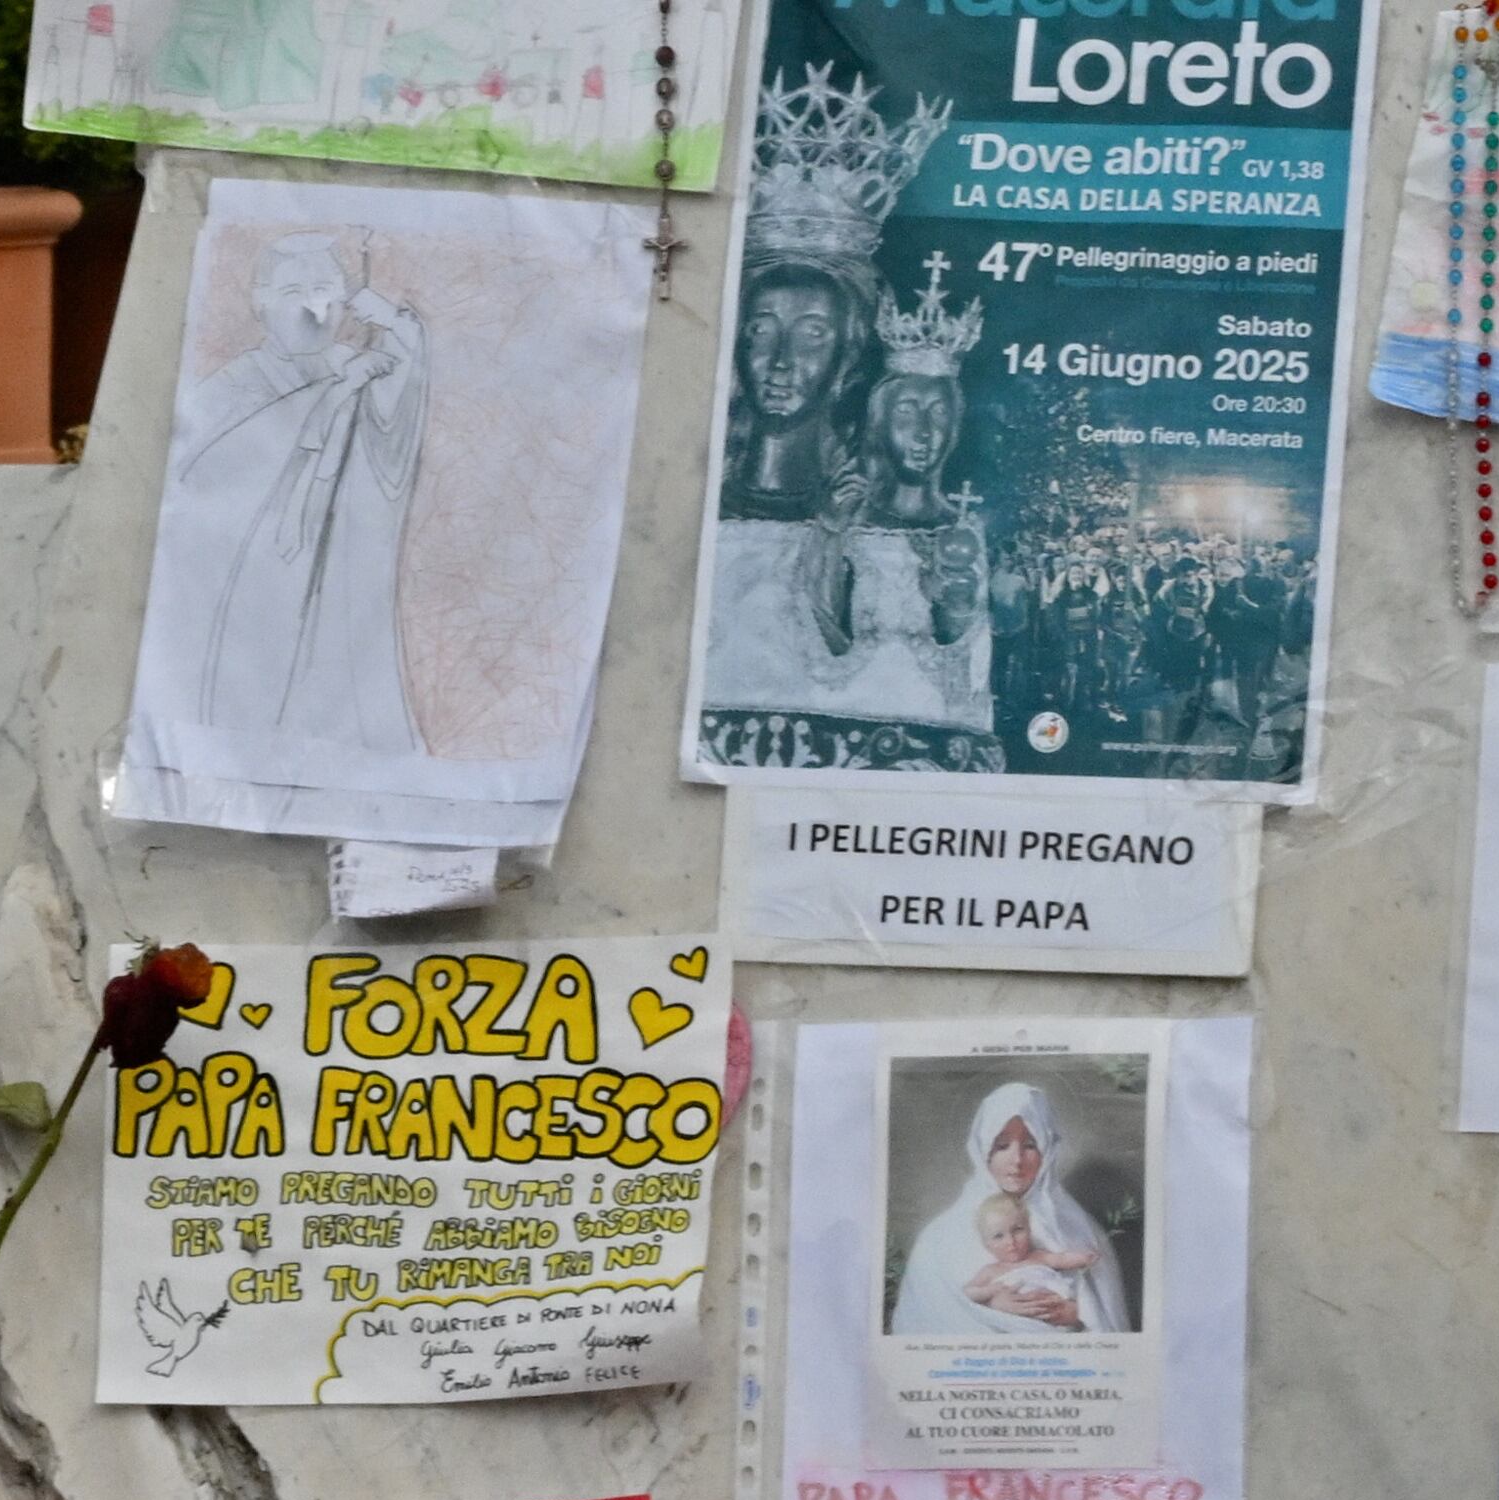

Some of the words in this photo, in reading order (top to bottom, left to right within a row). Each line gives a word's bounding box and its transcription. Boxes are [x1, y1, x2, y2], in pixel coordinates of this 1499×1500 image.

[1011, 17, 1333, 109] Loreto
[1241, 158, 1273, 179] GV
[1279, 159, 1324, 183] 1,38
[952, 183, 988, 208] LA
[995, 185, 1072, 211] CASA
[1079, 187, 1163, 213] DELLA
[1171, 188, 1321, 218] SPERANZA
[1056, 246, 1230, 275] Pellegrinaggio
[1235, 255, 1251, 270] a
[1256, 251, 1319, 276] piedi
[1217, 314, 1312, 339] Sabato
[1002, 343, 1043, 375] 14
[1056, 344, 1202, 387] Giugno
[1212, 347, 1310, 384] 2025
[1211, 393, 1248, 414] Ore
[1252, 394, 1307, 415] 20:30
[1076, 424, 1146, 446] Centro
[1149, 425, 1201, 450] fiere,
[1206, 427, 1303, 449] Macerata
[789, 823, 797, 852] I
[809, 824, 1007, 859] PELLEGRINI
[1019, 830, 1195, 865] PREGANO
[879, 895, 945, 925] PER
[956, 897, 984, 929] IL
[995, 898, 1090, 932] PAPA
[303, 953, 600, 1063] FORZA
[112, 1051, 285, 1158] PAPA
[311, 1066, 722, 1168] FRANCESCO
[279, 1171, 438, 1209] PREGANDO
[171, 1217, 224, 1258] PER
[235, 1214, 273, 1257] TE
[303, 1209, 403, 1250] PERCHÉ
[227, 1263, 302, 1305] CHE
[325, 1265, 379, 1302] TU
[543, 1249, 593, 1279] TRA
[362, 1318, 399, 1338] DAL
[410, 1314, 507, 1334] QUARTIERE
[517, 1312, 532, 1324] DI
[541, 1305, 584, 1323] PONTE
[591, 1303, 611, 1316] DI
[620, 1299, 676, 1315] NONA
[580, 1326, 652, 1359] Giuseppe
[507, 1366, 570, 1389] Antonio
[585, 1365, 641, 1382] FELICE
[899, 1389, 945, 1402] NELLA
[950, 1389, 1005, 1401] NOSTRA
[1055, 1389, 1067, 1401] O
[939, 1408, 957, 1420] CI
[960, 1407, 1080, 1420] CONSACRIAMO
[905, 1427, 924, 1439] AL
[928, 1426, 958, 1438] TUO
[960, 1426, 1009, 1437] CUORE
[1014, 1425, 1115, 1437] IMMACOLATO
